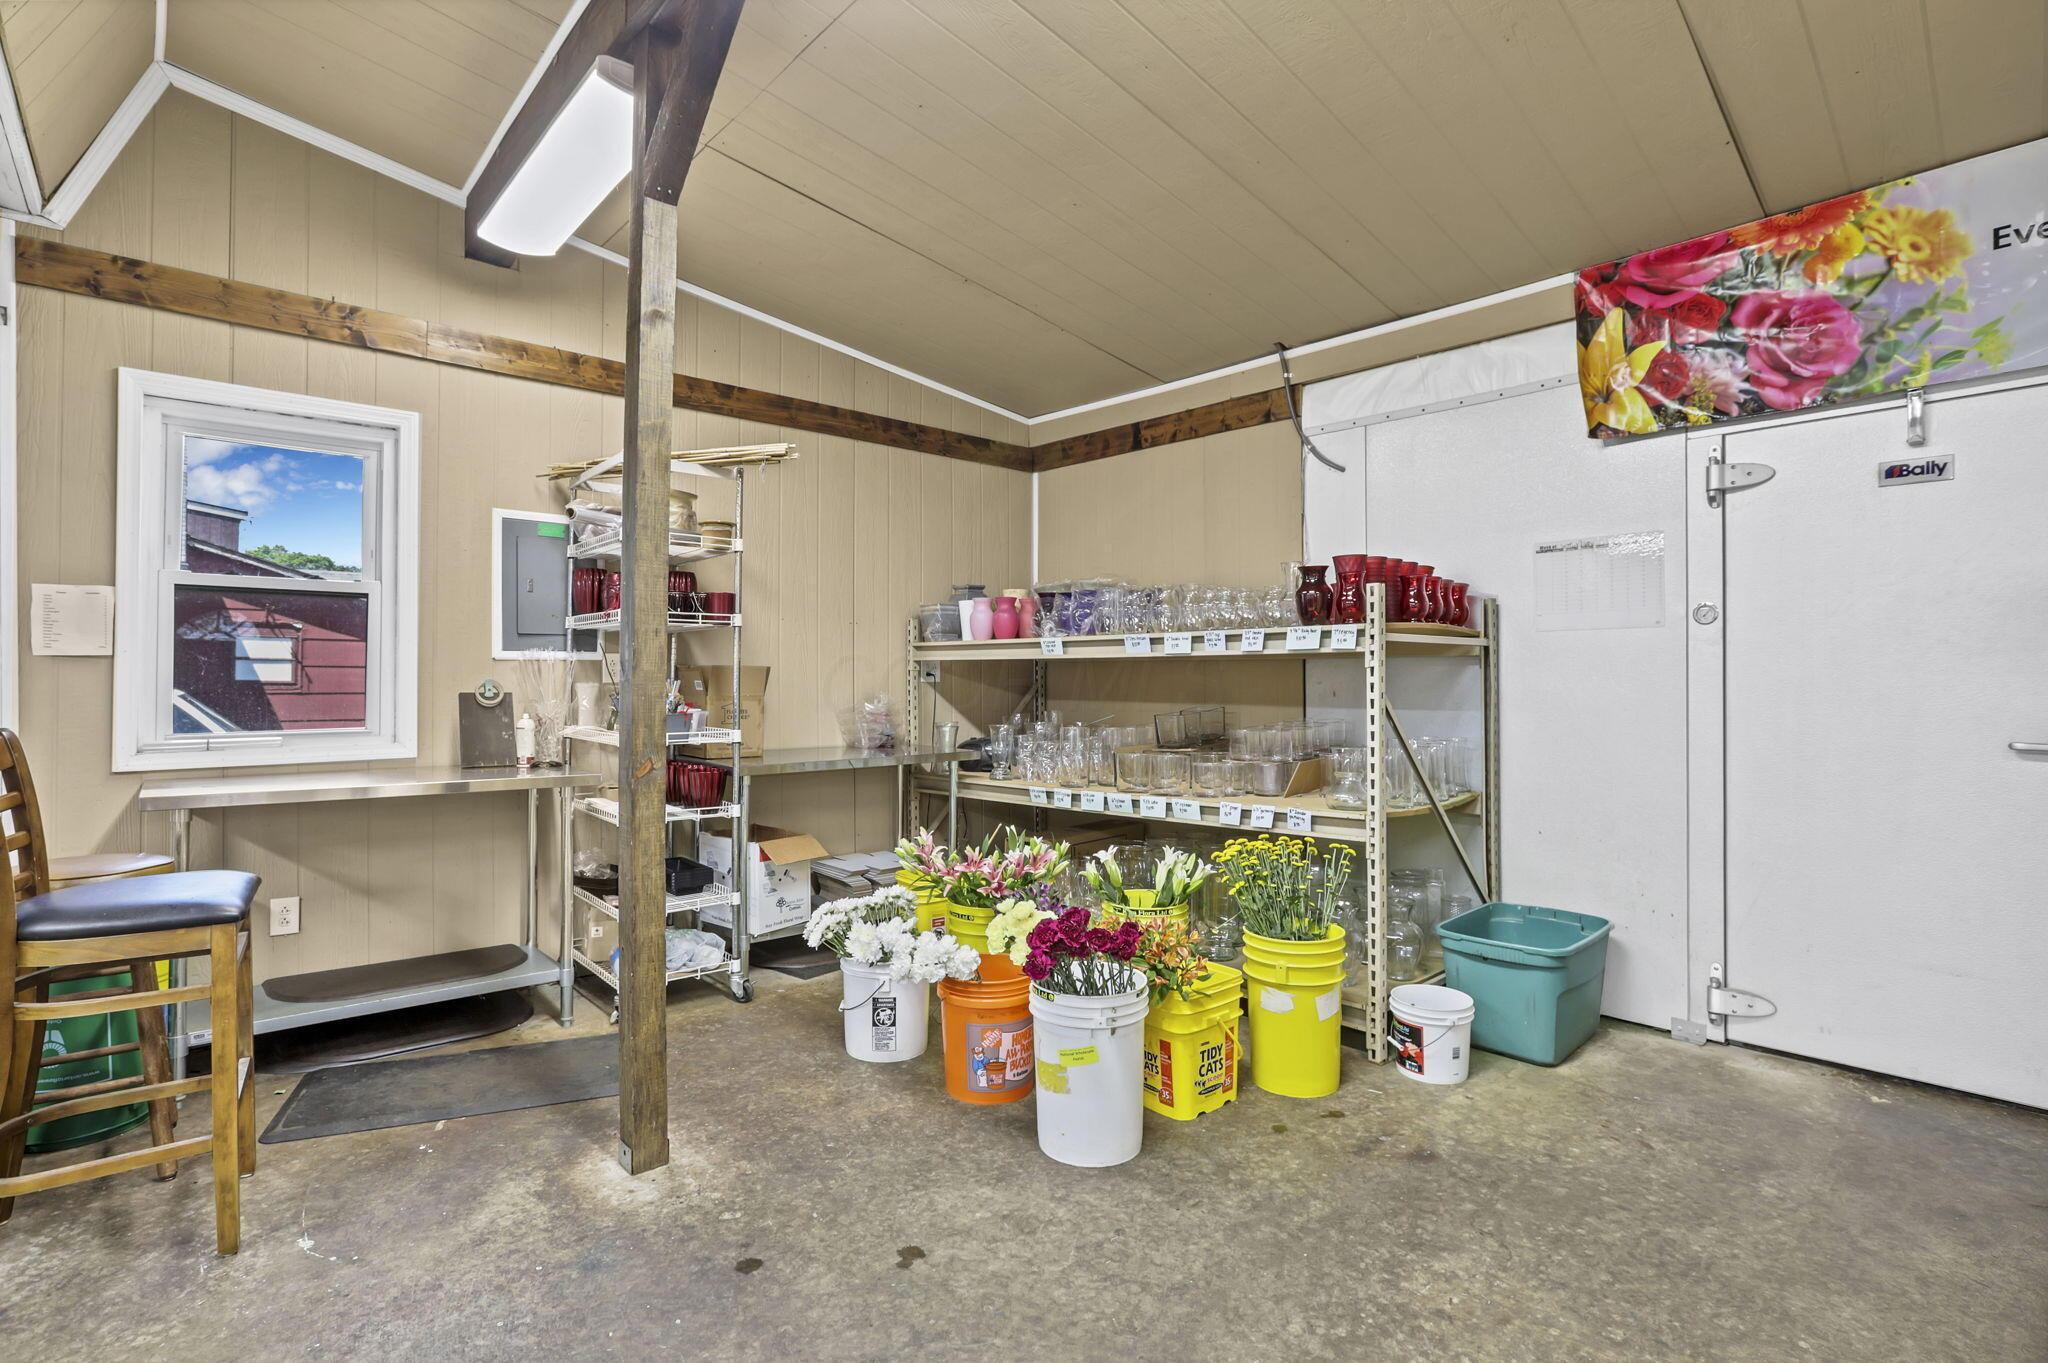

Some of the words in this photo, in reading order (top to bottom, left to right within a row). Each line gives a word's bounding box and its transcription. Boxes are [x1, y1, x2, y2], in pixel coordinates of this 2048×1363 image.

[1900, 460, 1948, 477] Bally
[1144, 1050, 1158, 1064] IDY
[1200, 1043, 1223, 1063] TIDY
[1144, 1061, 1160, 1075] ATS
[1199, 1057, 1224, 1077] CATS
[1161, 1089, 1170, 1100] 35
